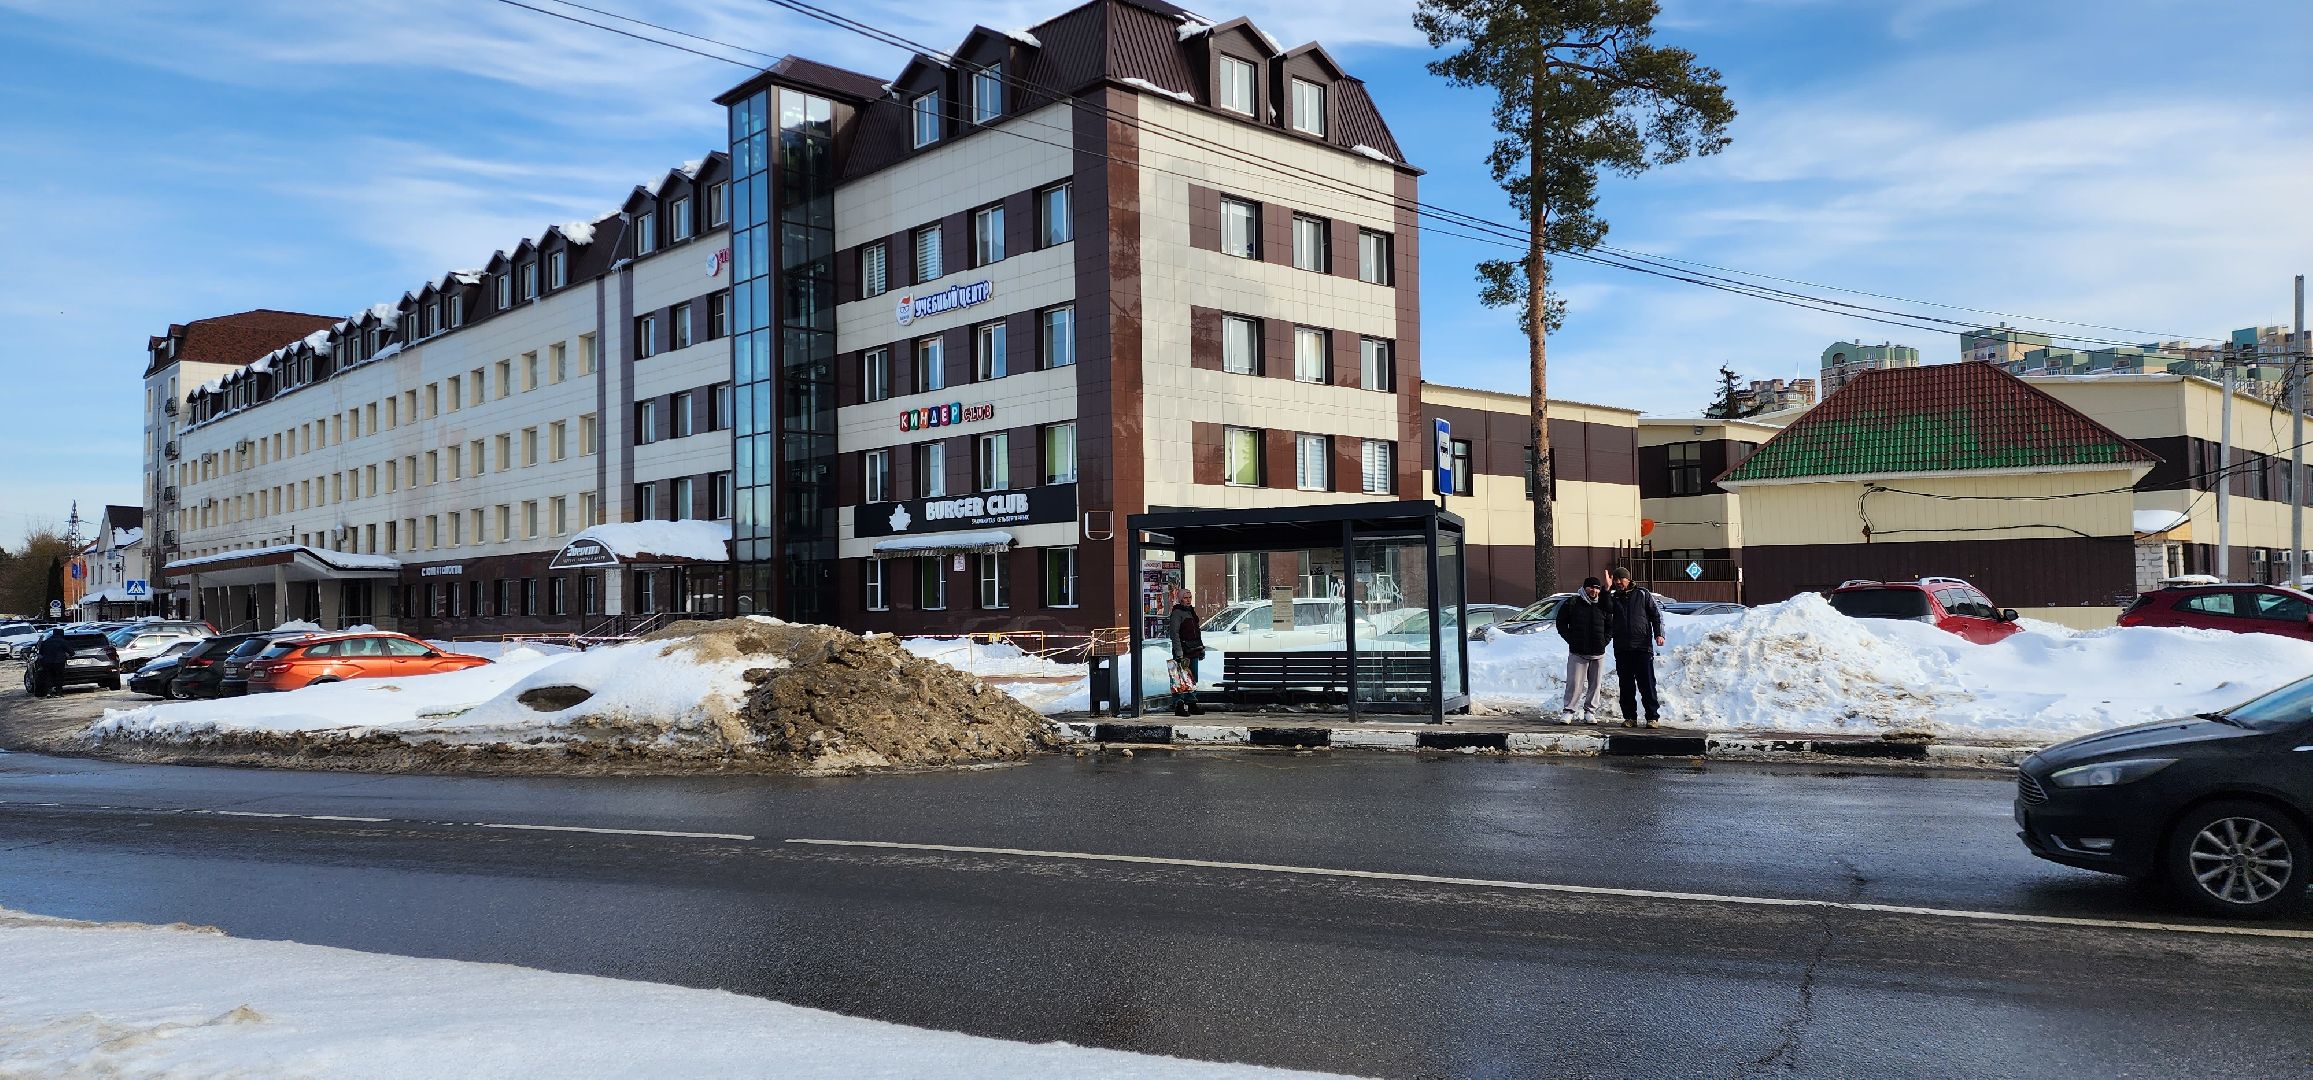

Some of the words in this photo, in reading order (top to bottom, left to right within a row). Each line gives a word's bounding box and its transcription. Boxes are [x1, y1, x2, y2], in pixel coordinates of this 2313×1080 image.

[915, 285, 957, 318] УЧЕБНЫЙ
[959, 280, 990, 309] ЦЕНТР
[900, 405, 959, 429] КИНДЕР
[963, 404, 992, 421] CLUB
[926, 497, 984, 520] BURGER
[987, 494, 1028, 515] CLUB
